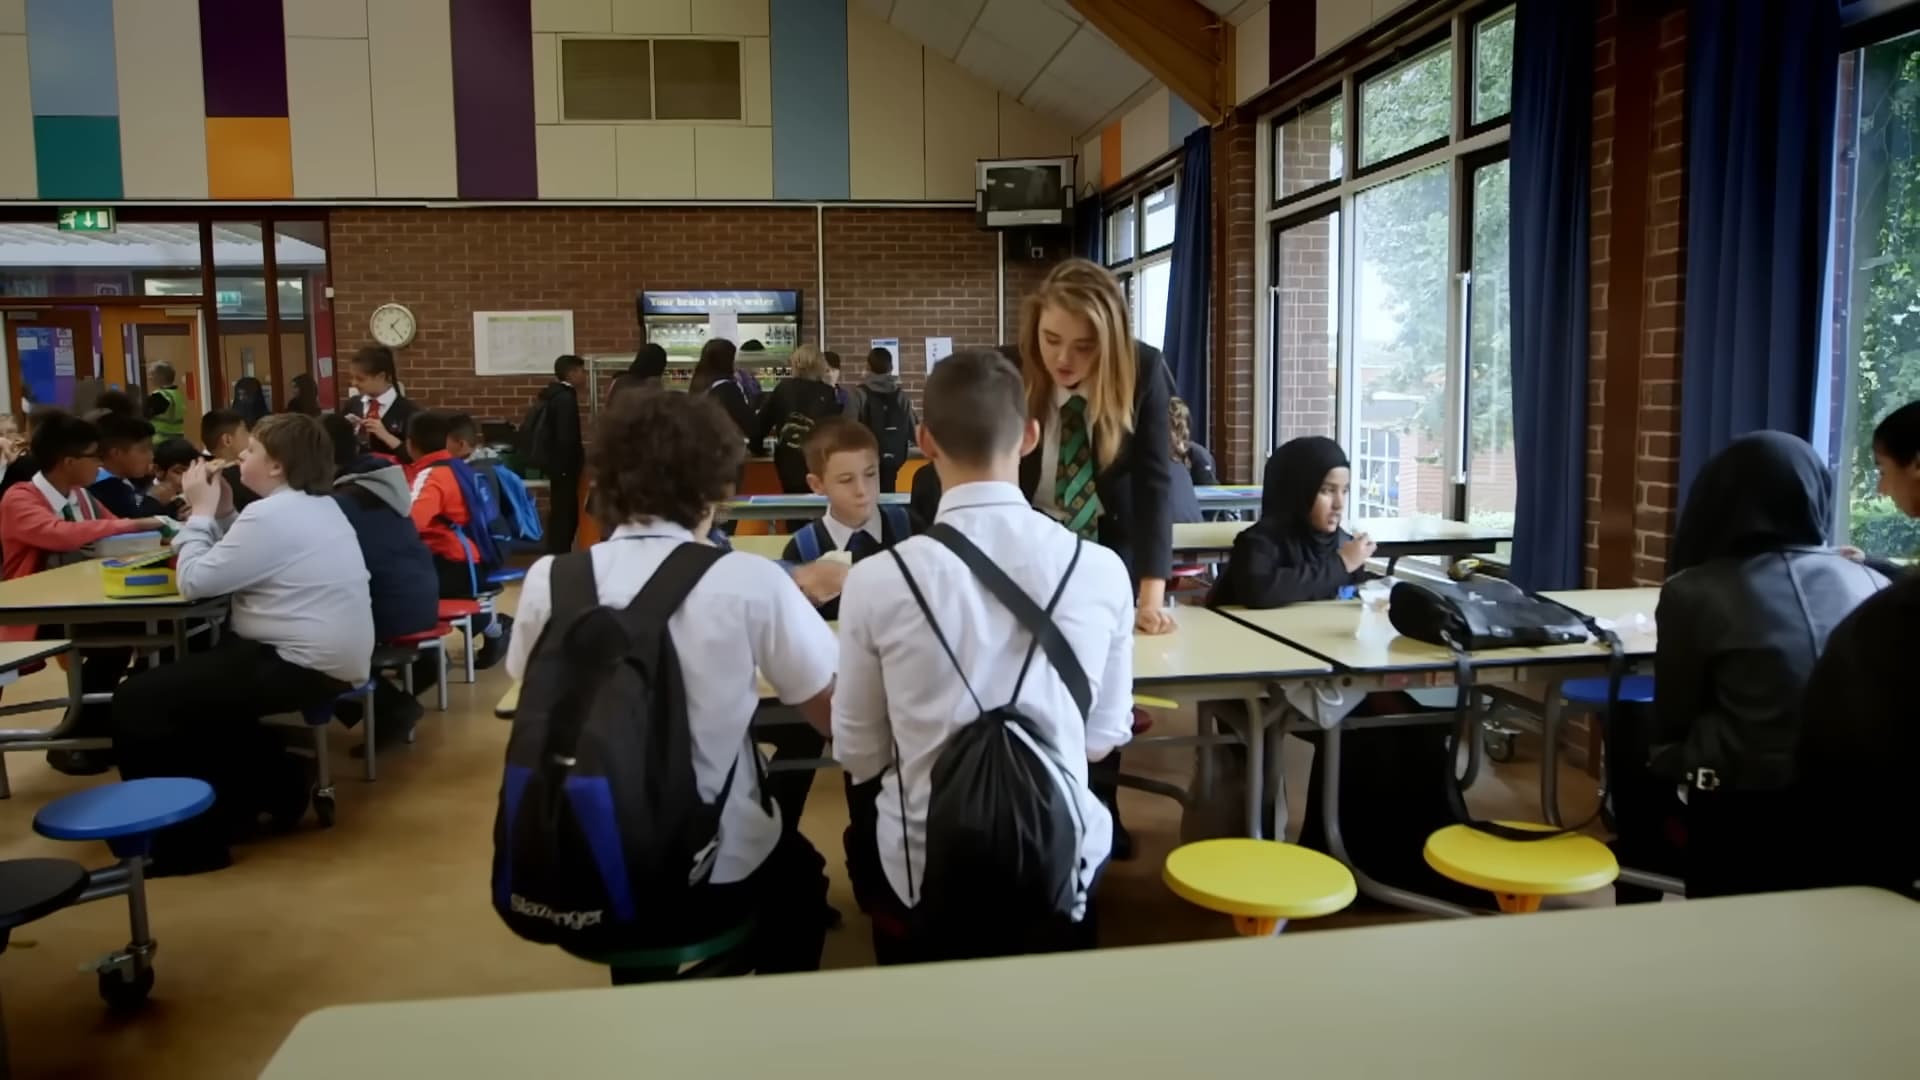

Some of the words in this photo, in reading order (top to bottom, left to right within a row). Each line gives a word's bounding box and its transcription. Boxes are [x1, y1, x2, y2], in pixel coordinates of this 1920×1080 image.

[649, 296, 674, 306] Your
[676, 295, 705, 306] brain
[708, 296, 717, 306] is
[744, 296, 775, 306] water
